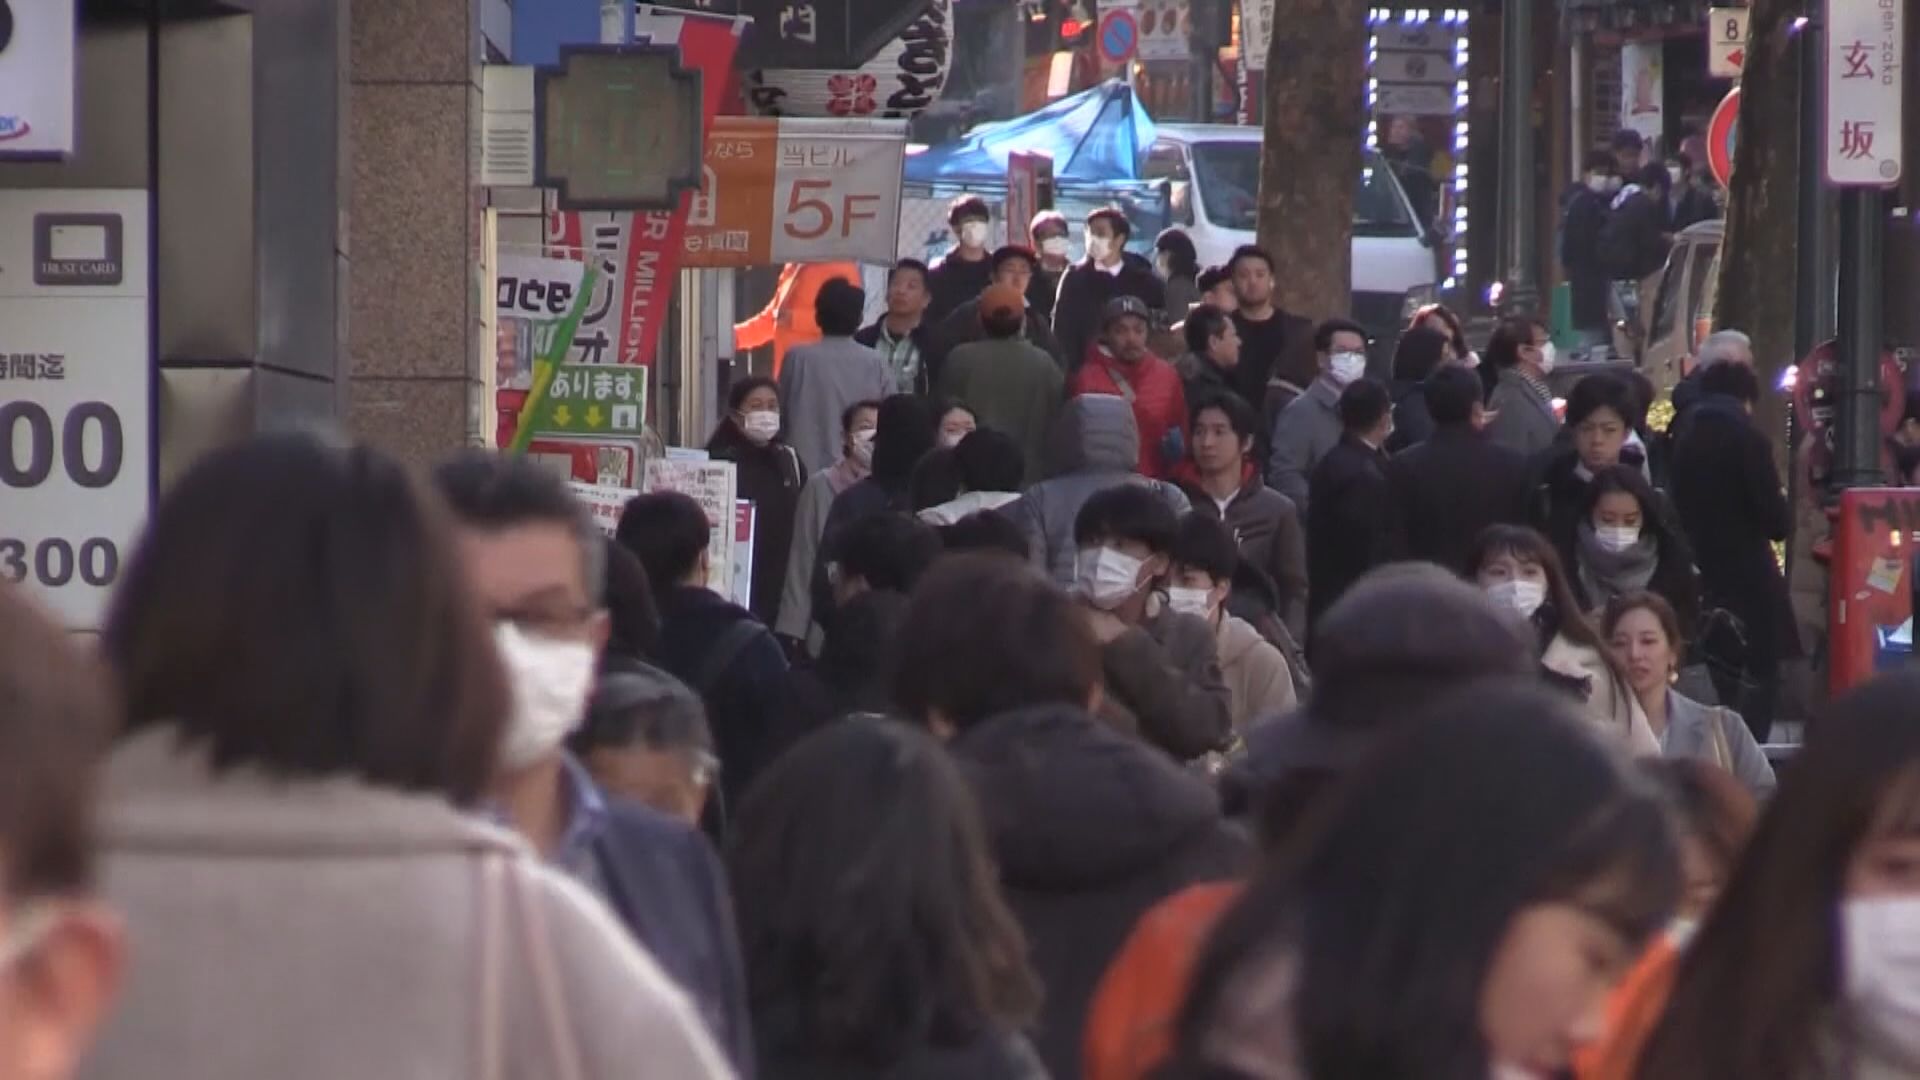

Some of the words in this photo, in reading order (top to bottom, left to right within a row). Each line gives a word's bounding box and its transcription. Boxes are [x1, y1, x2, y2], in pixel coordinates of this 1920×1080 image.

[1725, 18, 1739, 41] 8
[783, 143, 857, 168] 当ビル
[783, 179, 881, 240] 5F
[41, 262, 77, 274] TRUST
[79, 262, 116, 274] CARD
